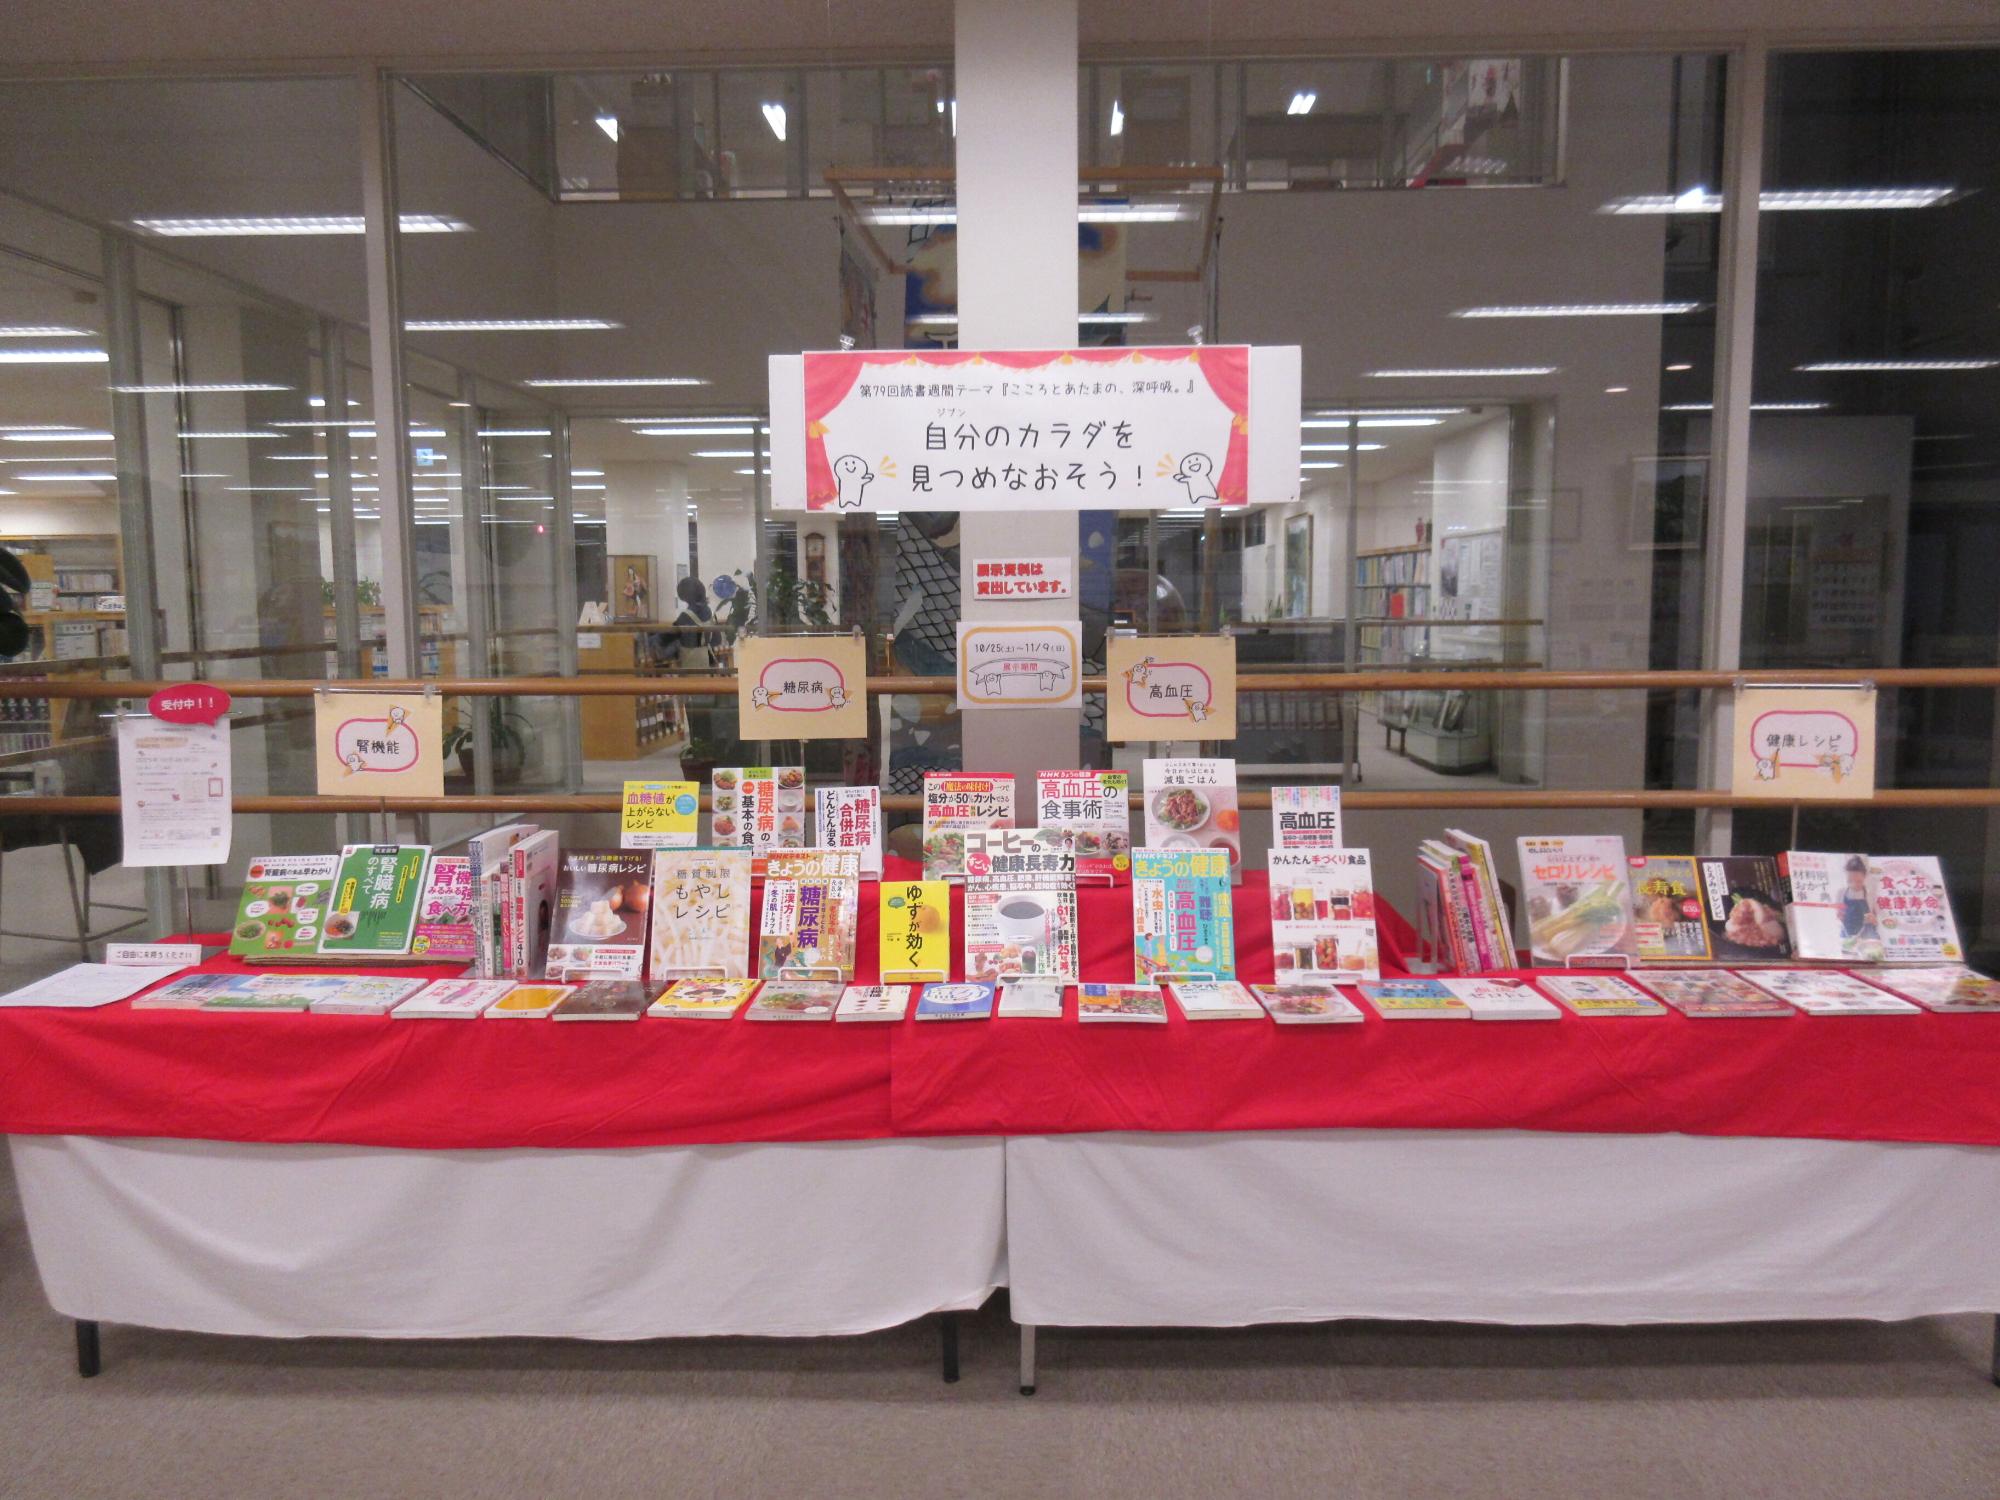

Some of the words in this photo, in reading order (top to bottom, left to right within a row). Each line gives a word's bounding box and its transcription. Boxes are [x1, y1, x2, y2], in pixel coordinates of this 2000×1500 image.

[859, 379, 1195, 399] 第79回読書週間テーマ『こころとあたまの、深呼吸。』
[936, 408, 967, 417] ジブン
[925, 421, 1134, 452] 自分のカラダを
[911, 461, 1143, 493] 見つめなおそう！
[976, 563, 1044, 577] 展示資料は
[977, 580, 1067, 595] 貸出しています。
[1003, 663, 1038, 672] 展示期間
[783, 680, 824, 695] 糖尿病
[1148, 682, 1195, 700] 高血圧
[356, 738, 400, 755] 腎機能
[1766, 733, 1843, 749] 健康レシピ
[1164, 775, 1217, 785] 減塩ごはん
[1041, 780, 1118, 799] 高血圧の
[627, 792, 676, 805] 血糖値が
[626, 806, 676, 817] 上がらない
[757, 781, 774, 842] 糖尿病の
[1041, 800, 1103, 820] 食事術
[626, 819, 654, 829] レシピ
[839, 803, 854, 847] 合併症
[855, 798, 872, 847] 糖尿病
[1279, 811, 1335, 830] 高血圧
[966, 830, 1041, 853] コーヒーの
[563, 863, 648, 874] おいしい糖尿病レシピ
[768, 854, 859, 877] きょうの健康
[967, 856, 991, 872] すごい
[991, 854, 1075, 873] 健康長寿力
[1135, 855, 1228, 877] きょうの健康
[1272, 855, 1367, 865] かんたん手づくり食品
[362, 856, 379, 895] のすべて
[676, 867, 732, 880] 糖質制限
[1530, 864, 1618, 881] セロリレシピ
[369, 857, 398, 909] 腎臓病
[676, 883, 730, 900] もやし
[675, 903, 731, 919] レシピ
[1877, 896, 1939, 910] 健康寿命
[797, 886, 822, 949] 糖尿病
[905, 885, 923, 967] ゆずが効く
[1176, 891, 1198, 951] 高血圧
